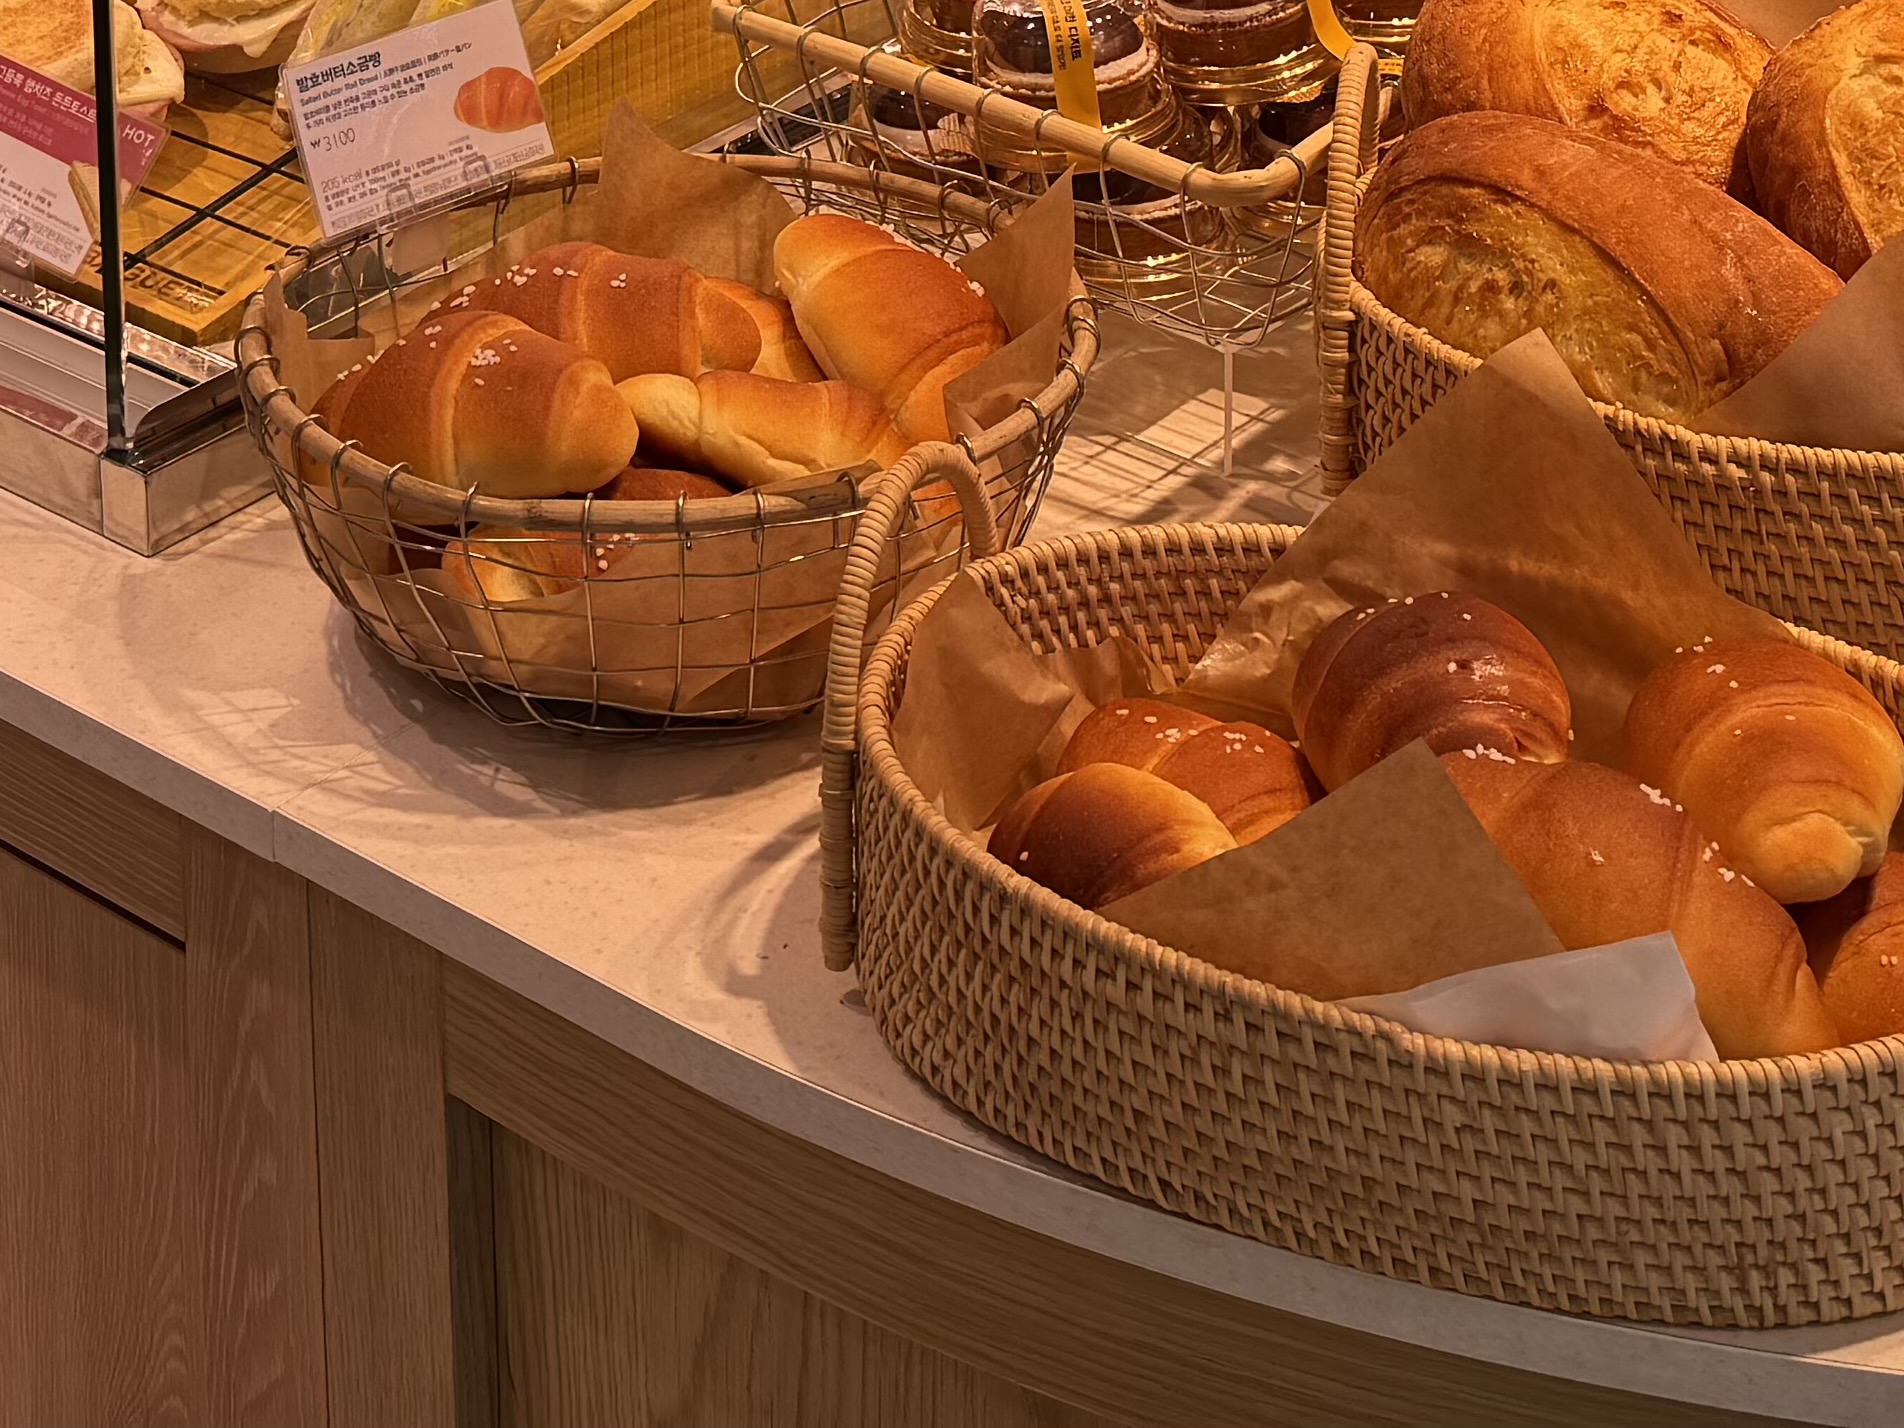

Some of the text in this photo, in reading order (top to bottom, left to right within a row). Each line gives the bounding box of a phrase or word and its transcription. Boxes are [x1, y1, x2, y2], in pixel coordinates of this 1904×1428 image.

[295, 51, 382, 93] 발효버터소금빵
[122, 124, 156, 147] HOT
[310, 127, 356, 152] ₩3100
[341, 168, 363, 185] kcal
